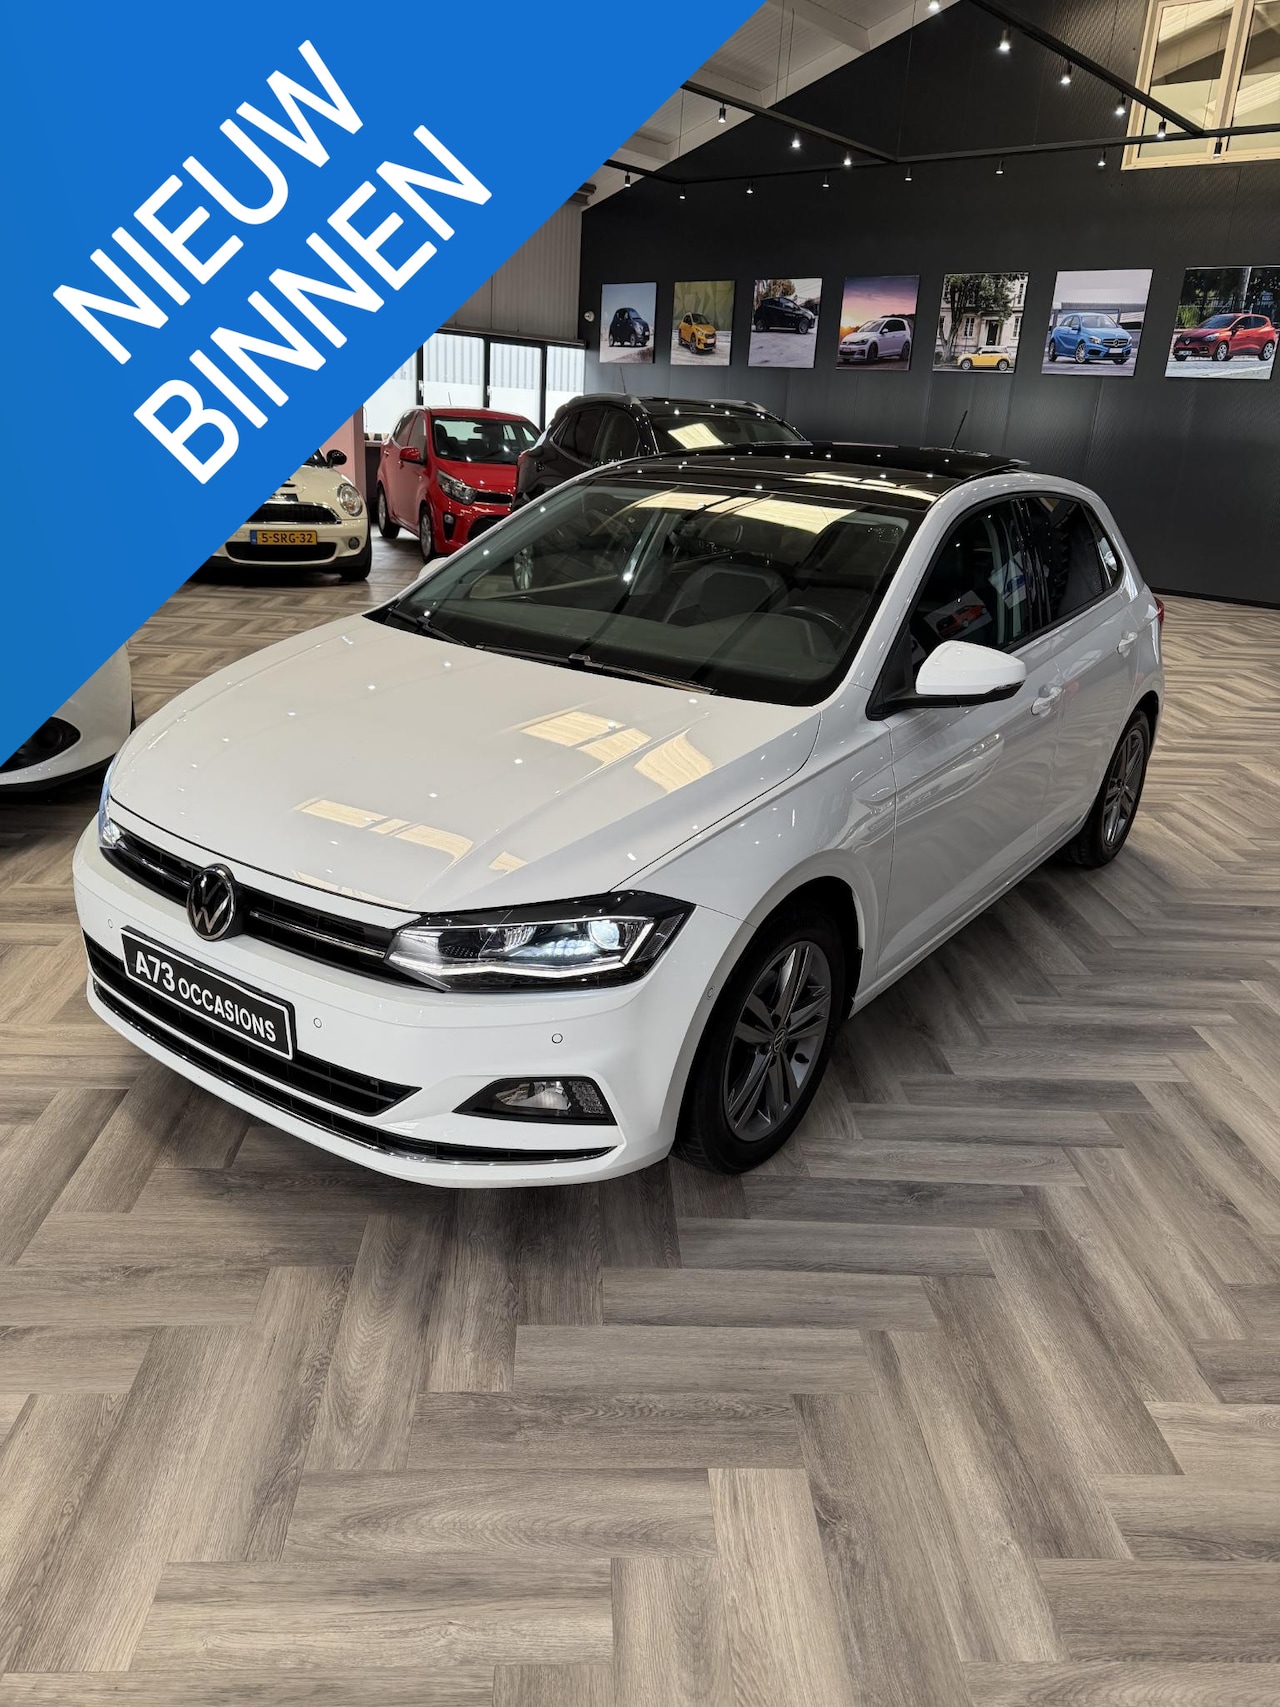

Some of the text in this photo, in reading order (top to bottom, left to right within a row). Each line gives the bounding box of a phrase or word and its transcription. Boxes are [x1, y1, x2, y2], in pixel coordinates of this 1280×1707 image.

[261, 532, 313, 543] 5-SRG-32
[135, 950, 277, 1043] A73 OCCASIONS
